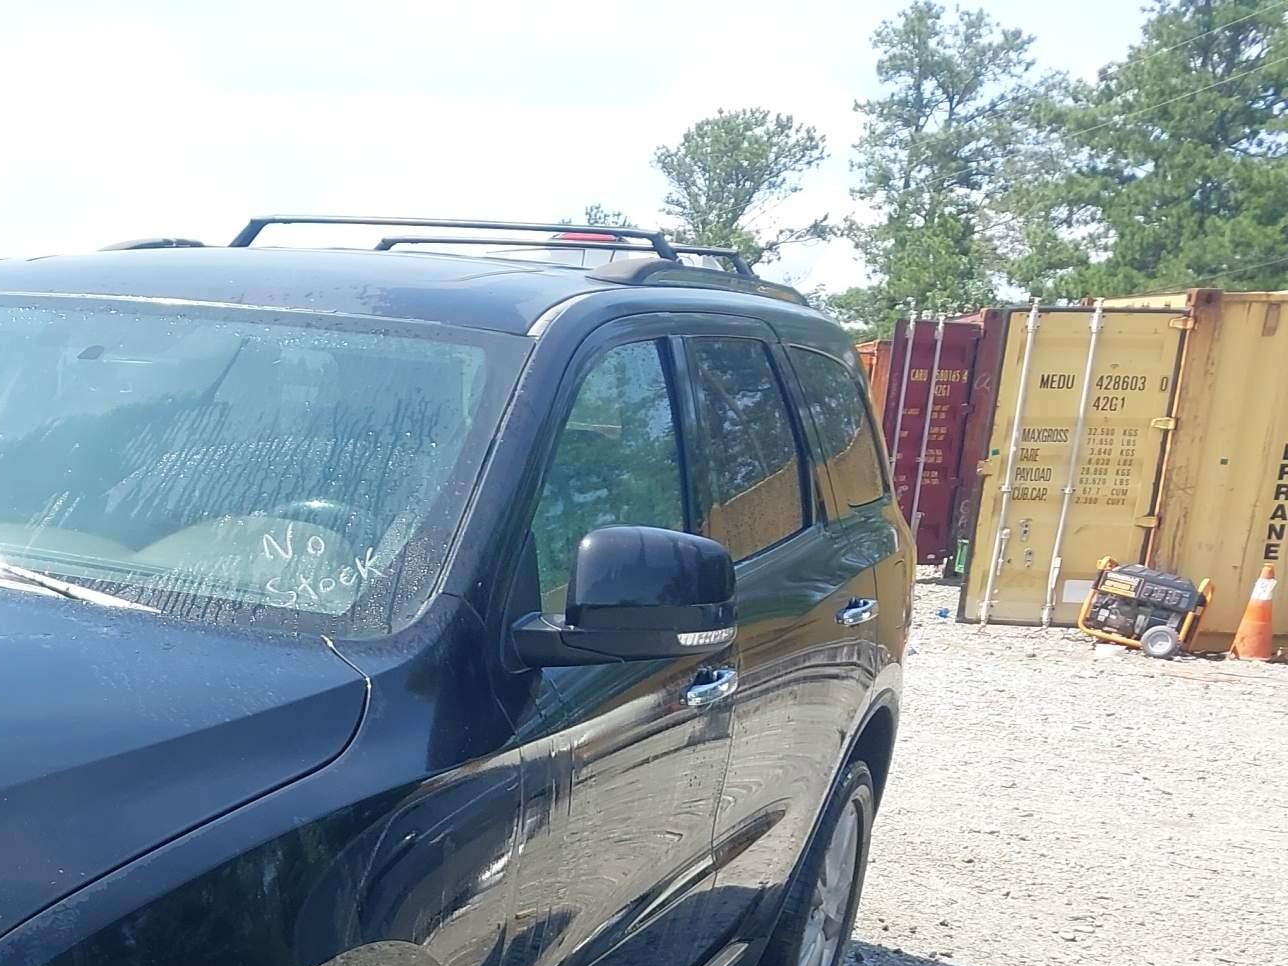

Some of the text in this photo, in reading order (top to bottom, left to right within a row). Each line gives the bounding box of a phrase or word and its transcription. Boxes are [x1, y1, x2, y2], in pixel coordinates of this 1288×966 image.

[1039, 374, 1076, 390] MEDU
[1095, 375, 1147, 391] 428603
[1092, 396, 1126, 411] 42G1
[1122, 428, 1139, 437] KGS
[1120, 438, 1137, 447] LBS
[1019, 447, 1040, 462] TARE
[1119, 448, 1136, 457] KGS
[1015, 466, 1052, 482] PAYLOAD
[1115, 468, 1132, 477] KGS
[263, 521, 326, 559] No
